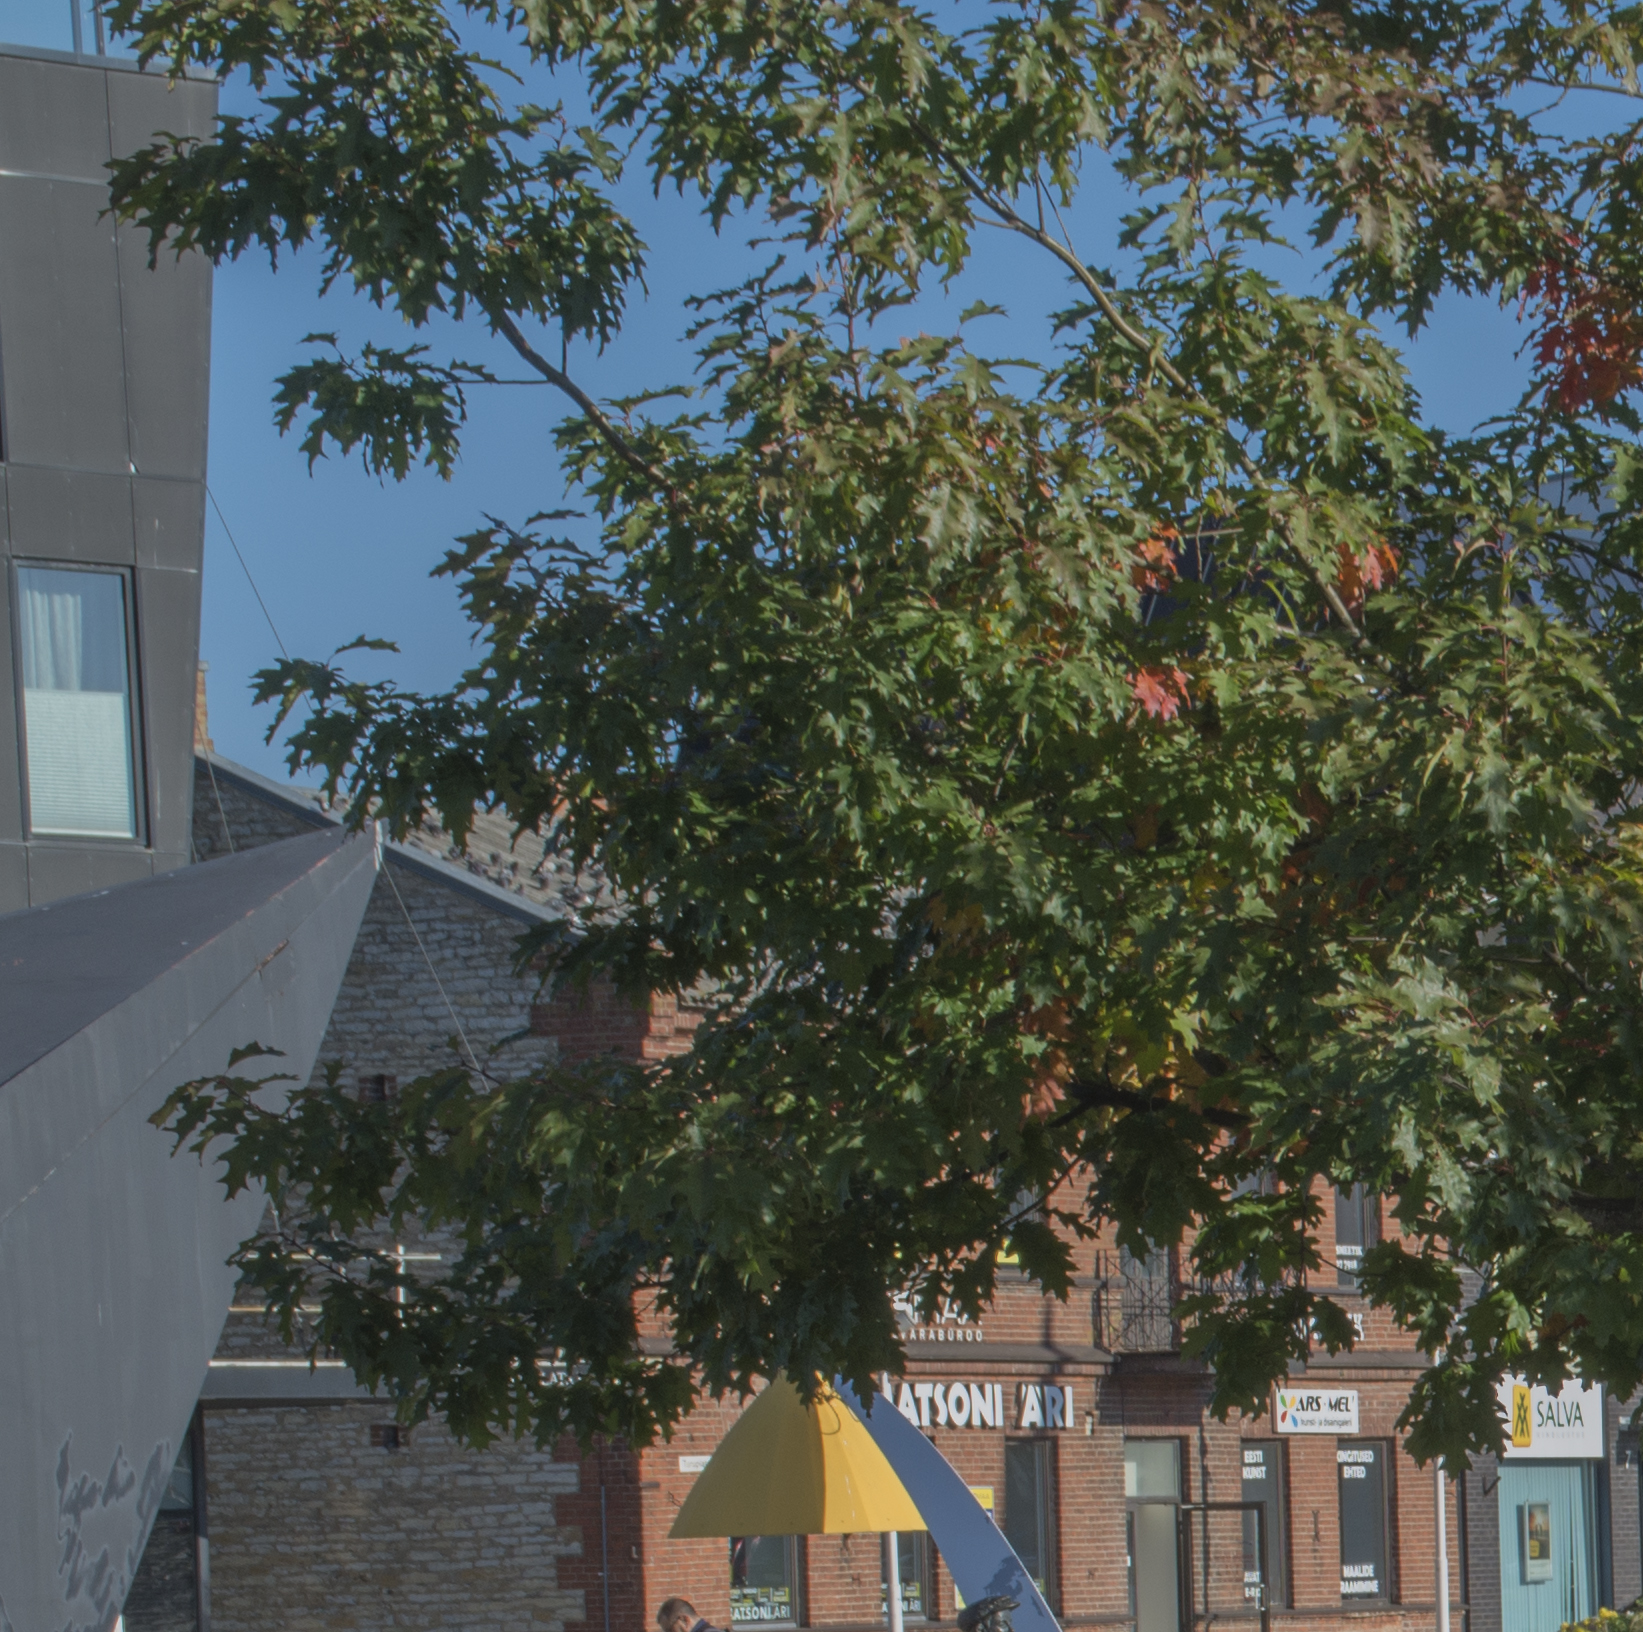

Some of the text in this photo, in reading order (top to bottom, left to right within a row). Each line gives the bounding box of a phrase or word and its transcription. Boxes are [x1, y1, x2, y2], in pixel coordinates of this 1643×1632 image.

[1021, 1384, 1075, 1427] ÄRI
[1296, 1395, 1322, 1412] ARS
[1536, 1400, 1585, 1428] SALVA
[1243, 1450, 1264, 1463] EESTI
[1242, 1466, 1267, 1479] KUNST
[1343, 1466, 1366, 1479] EHTED
[1343, 1565, 1375, 1578] MAALIDE
